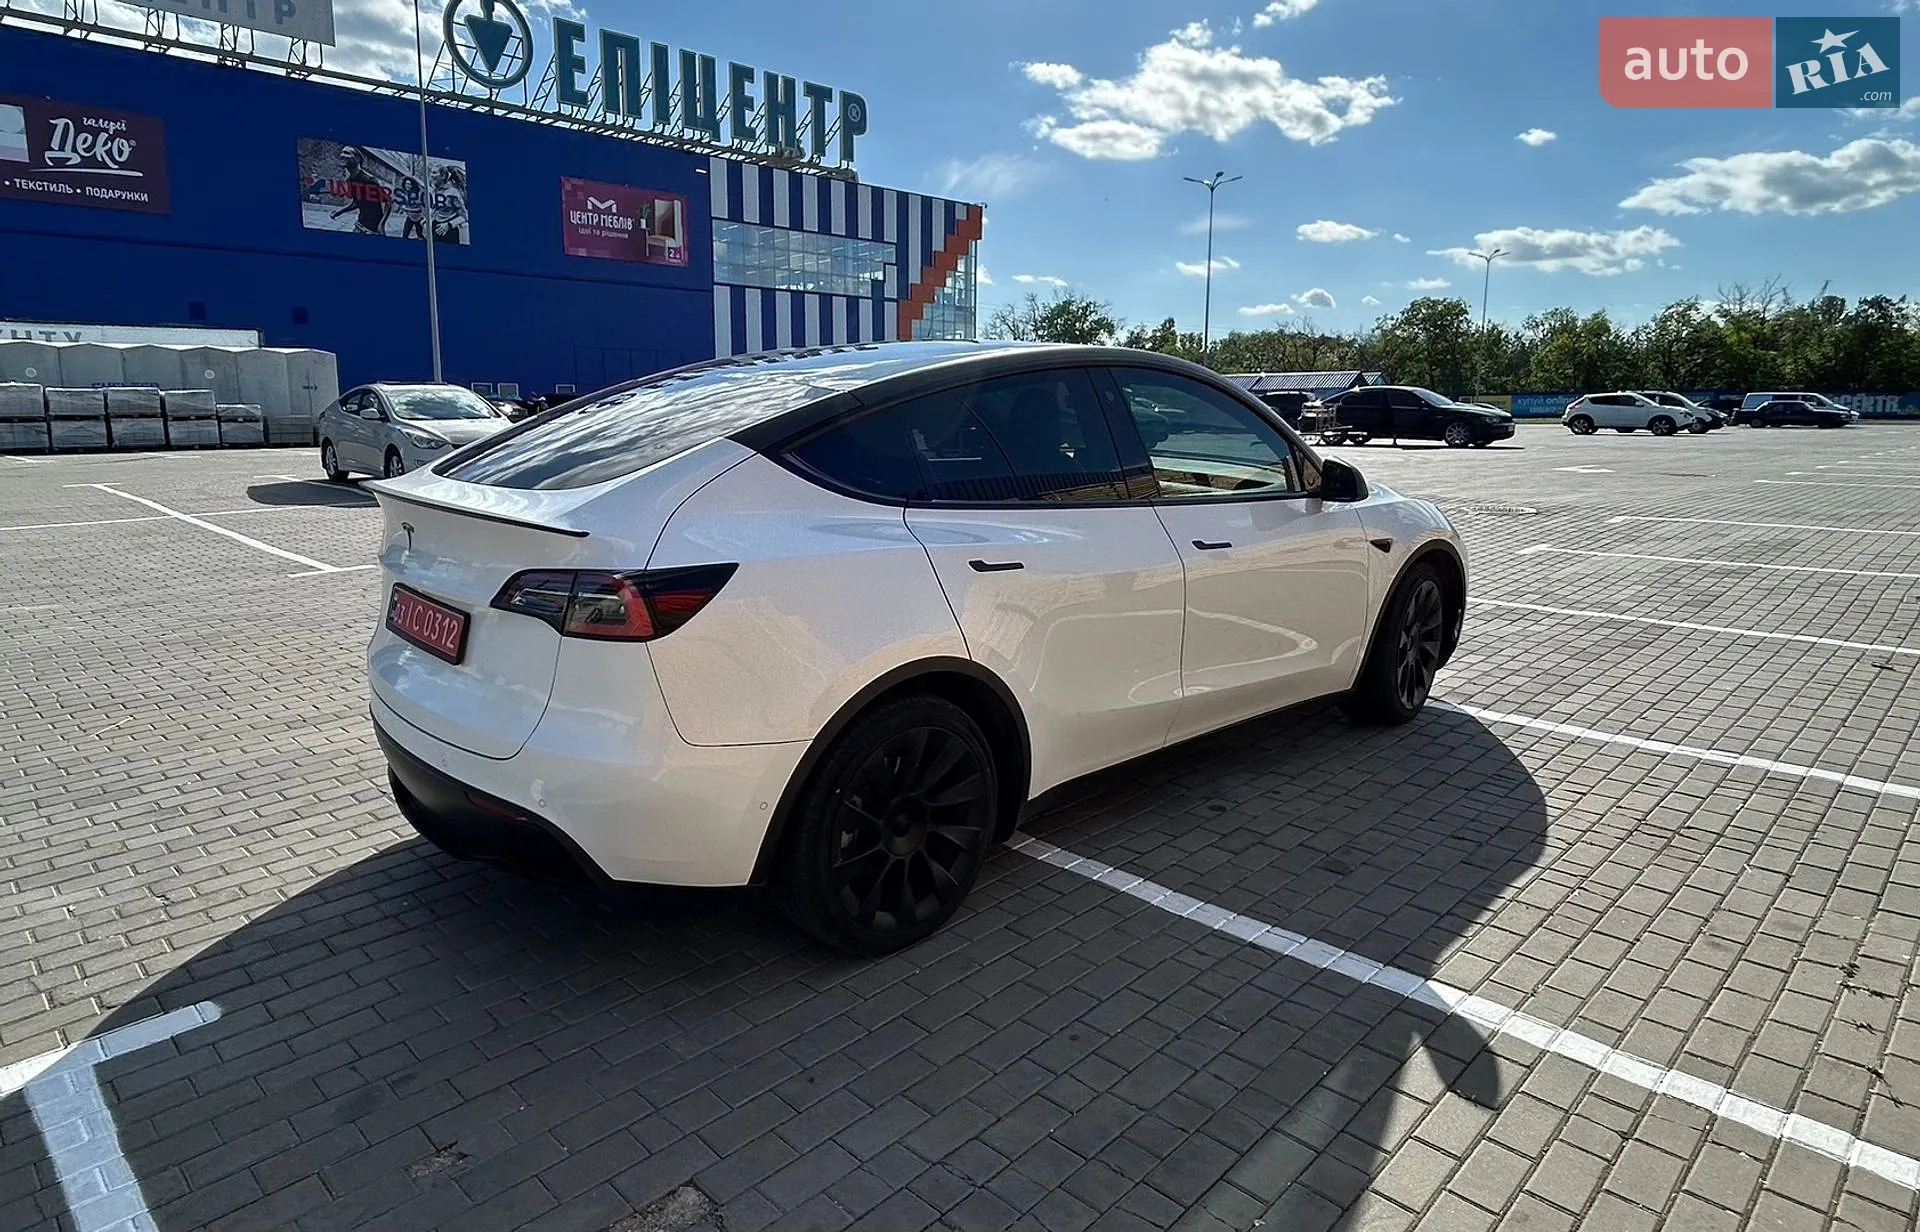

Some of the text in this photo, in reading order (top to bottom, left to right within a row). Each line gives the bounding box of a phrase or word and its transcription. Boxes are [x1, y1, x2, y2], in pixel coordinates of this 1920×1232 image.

[554, 17, 868, 162] ЕПІЦЕНТР
[14, 178, 149, 202] ТЕКСТИЛЬ ПОДАРУНКИ
[570, 210, 633, 231] ЦЕНТР МЕБЛІВ
